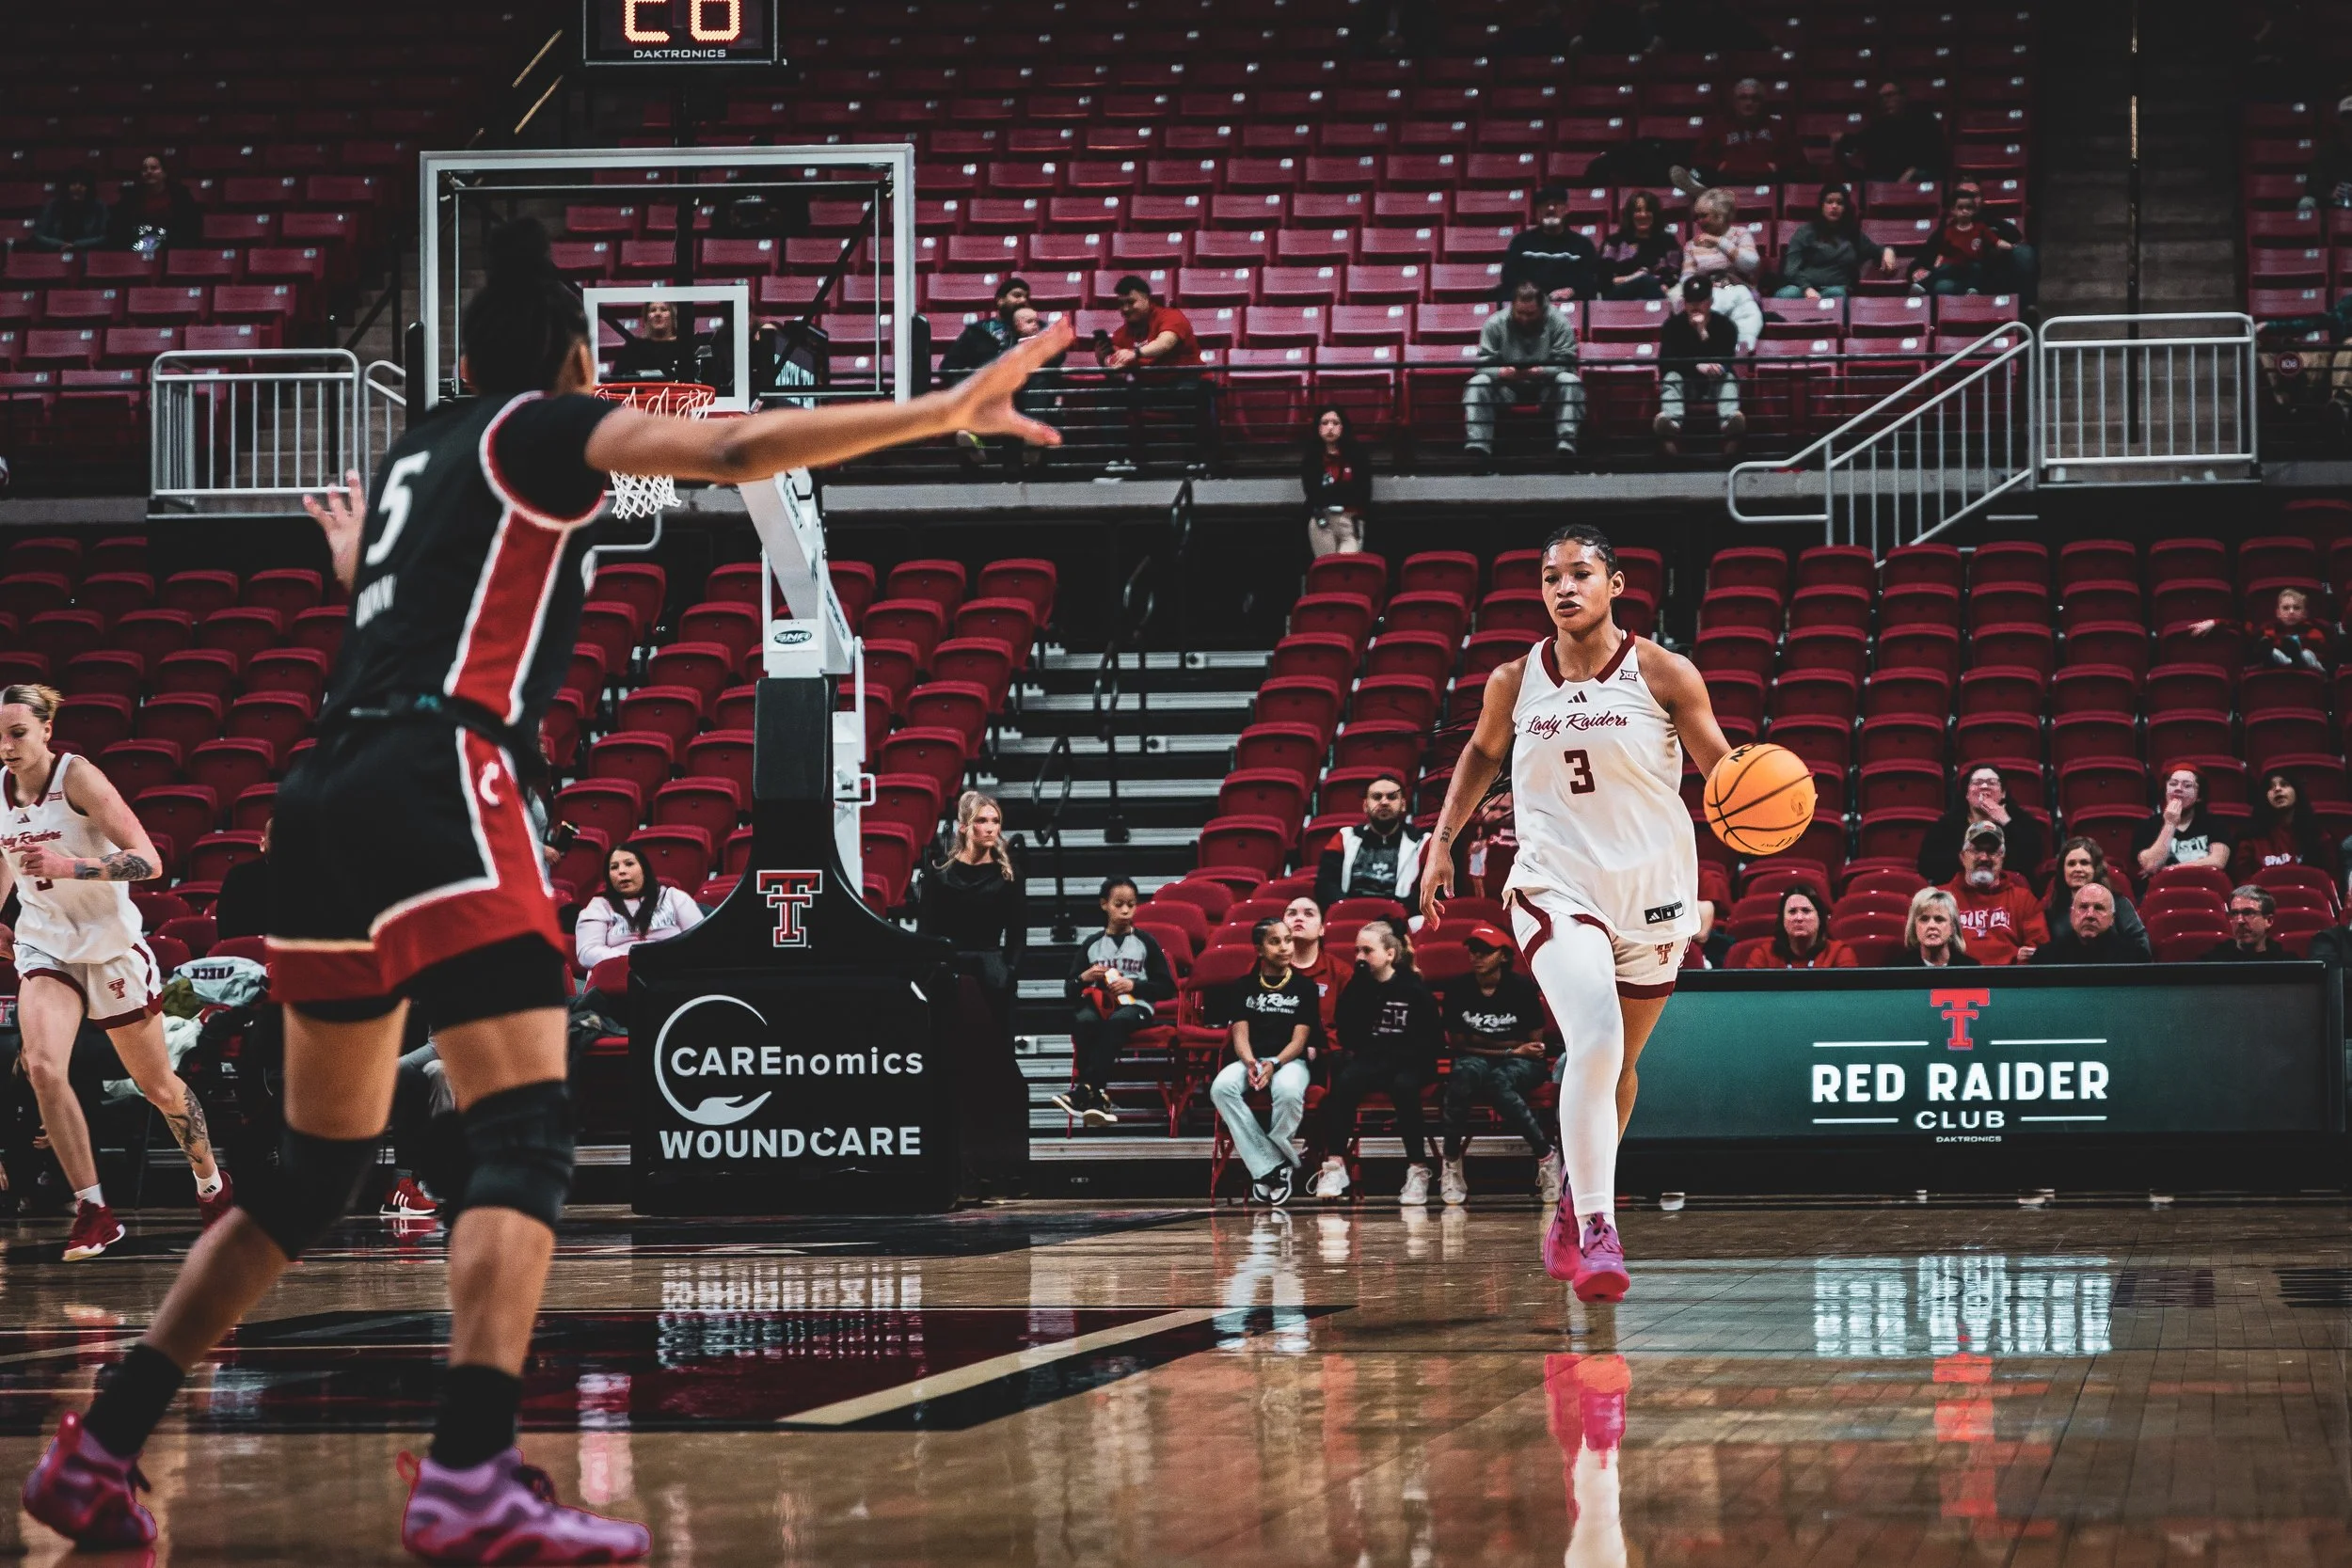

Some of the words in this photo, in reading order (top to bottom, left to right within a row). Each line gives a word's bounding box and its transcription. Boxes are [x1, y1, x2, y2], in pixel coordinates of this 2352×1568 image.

[633, 49, 726, 58] DAKTRONICS
[365, 450, 431, 566] 5
[1526, 714, 1562, 740] Lady
[1565, 711, 1629, 731] Raiders
[1564, 749, 1596, 795] 3
[671, 1046, 924, 1077] CAREnomics
[1812, 1063, 1906, 1102] RED
[1927, 1061, 2109, 1101] RAIDER
[1914, 1110, 2006, 1130] CLUB
[659, 1126, 922, 1159] WOUNDCARE
